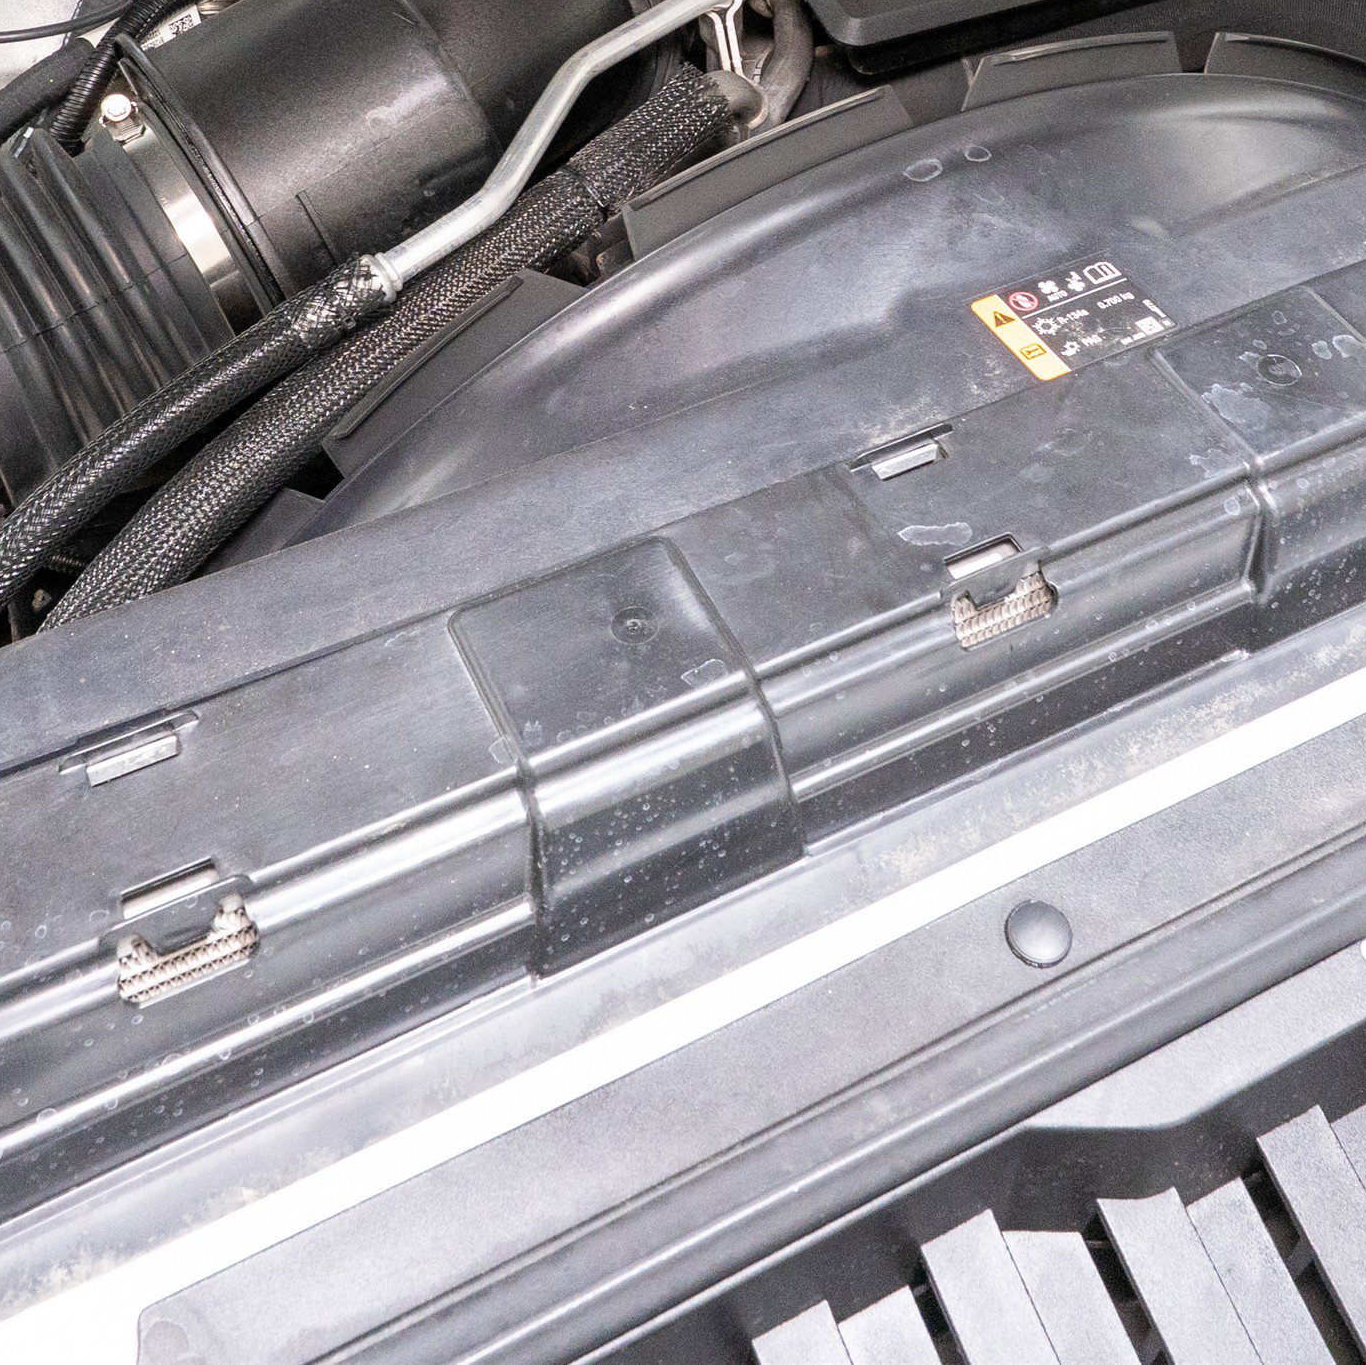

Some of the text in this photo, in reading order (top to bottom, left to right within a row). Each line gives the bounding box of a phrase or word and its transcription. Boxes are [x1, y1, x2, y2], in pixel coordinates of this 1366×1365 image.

[1047, 290, 1068, 302] AUTO
[1056, 309, 1090, 325] R-134a
[1096, 295, 1123, 309] 0.700
